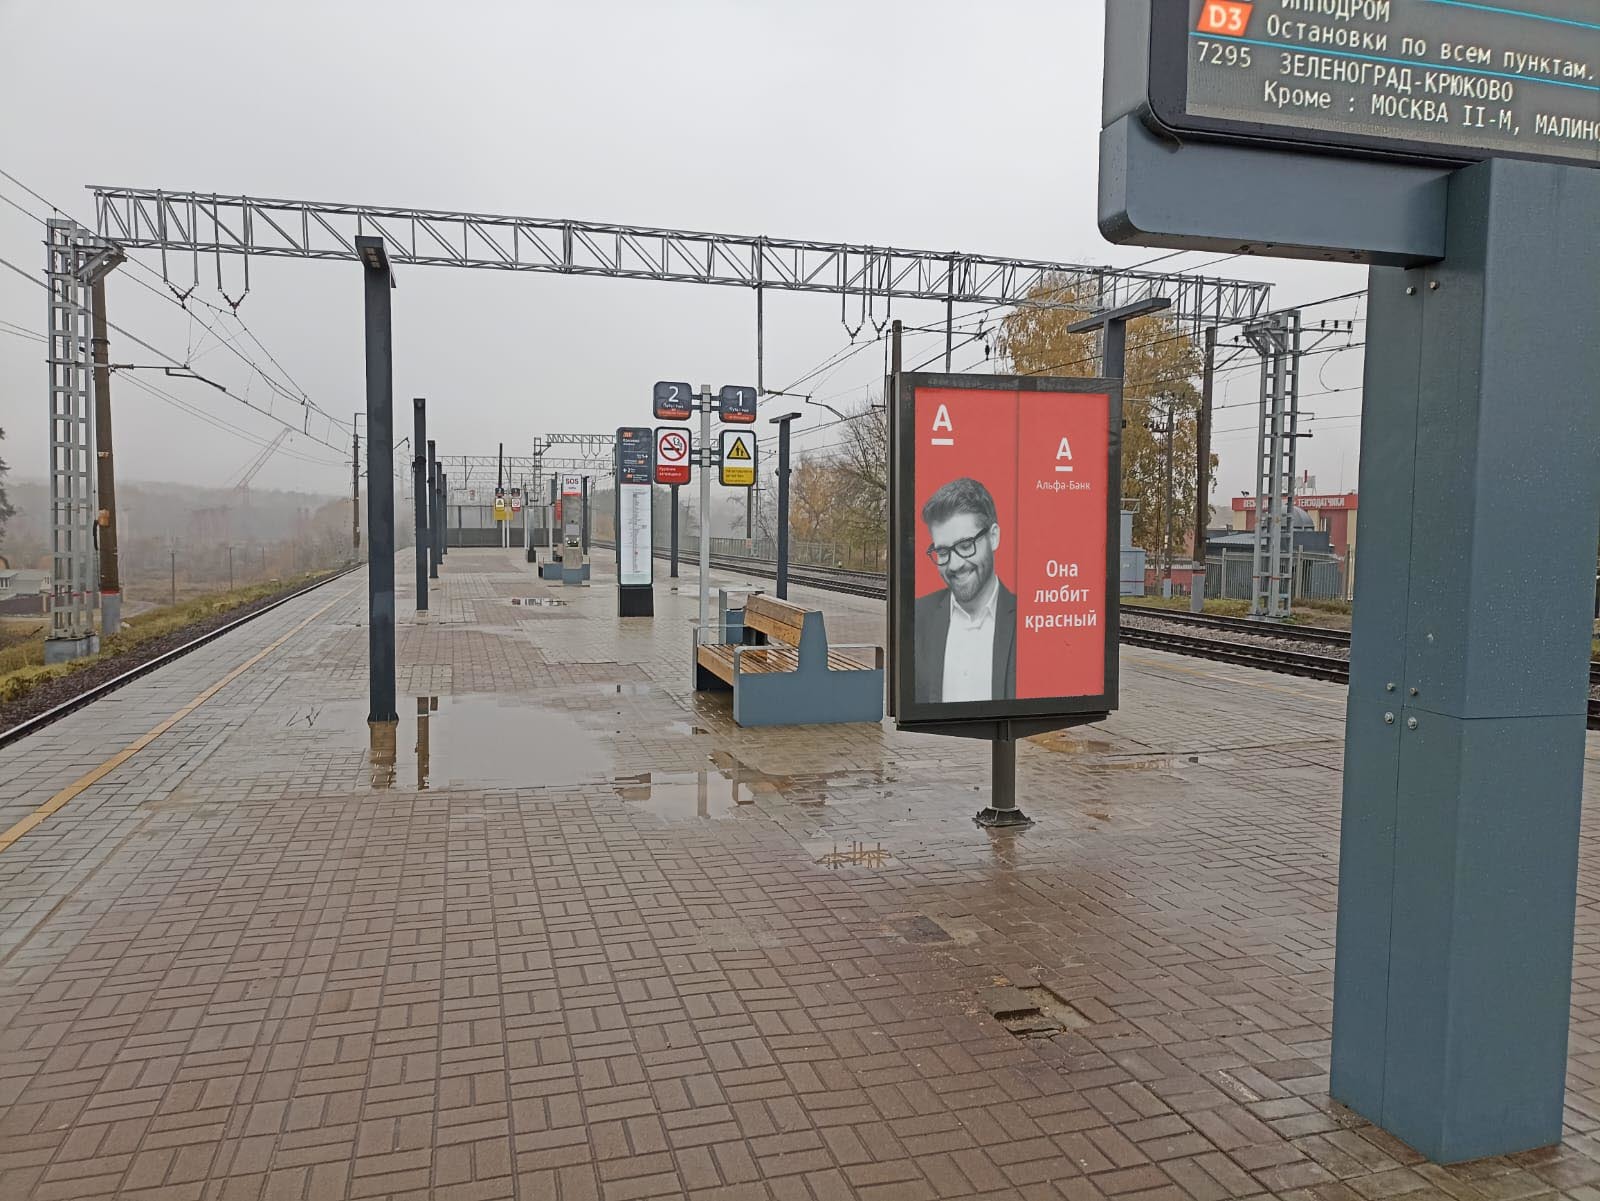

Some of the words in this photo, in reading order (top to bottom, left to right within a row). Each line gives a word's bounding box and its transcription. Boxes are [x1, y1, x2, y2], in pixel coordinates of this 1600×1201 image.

[1208, 4, 1243, 31] D3
[1267, 14, 1388, 52] Остановки
[1401, 37, 1427, 57] по
[1440, 42, 1491, 65] всем
[1503, 51, 1594, 81] пунктам.
[1196, 42, 1252, 69] 7295
[1279, 53, 1514, 103] ЗЕЛЕНОГРАД-КРЮКОВО
[1264, 80, 1332, 109] Кроме
[1371, 93, 1449, 124] МОСКВА
[668, 385, 679, 403] 2
[736, 390, 743, 407] 1
[1036, 479, 1091, 492] Альфа-Банк
[1045, 559, 1079, 577] Она
[1034, 585, 1089, 603] любит
[1025, 609, 1097, 633] красный
